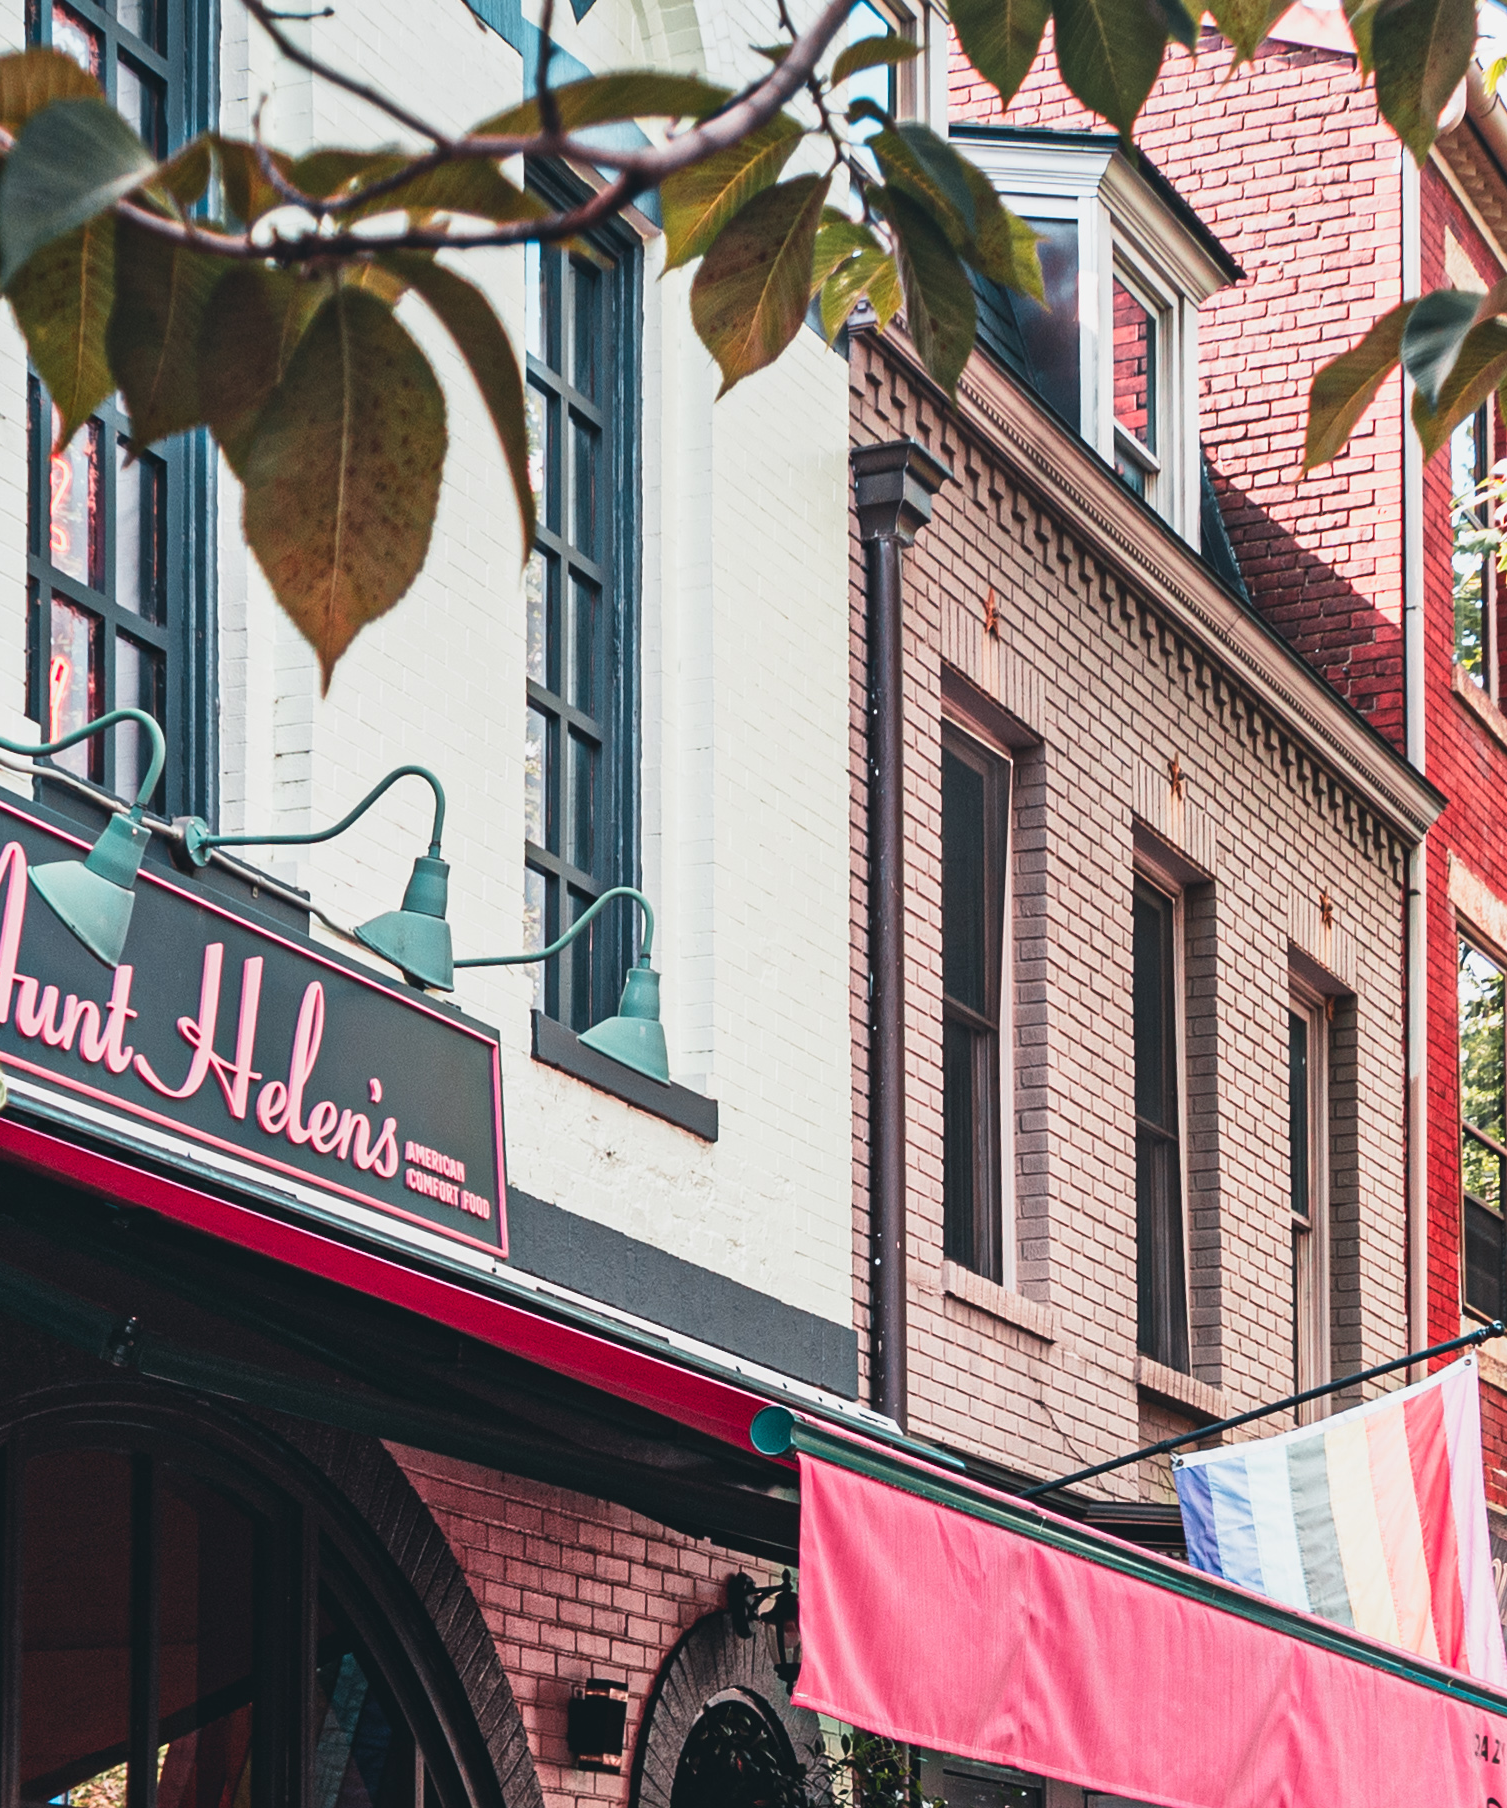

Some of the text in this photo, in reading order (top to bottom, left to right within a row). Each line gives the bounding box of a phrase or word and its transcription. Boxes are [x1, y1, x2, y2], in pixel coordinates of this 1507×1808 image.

[133, 942, 398, 1178] Helen's
[404, 1141, 465, 1183] AMERICAN
[405, 1168, 491, 1220] COMFORT FOOD
